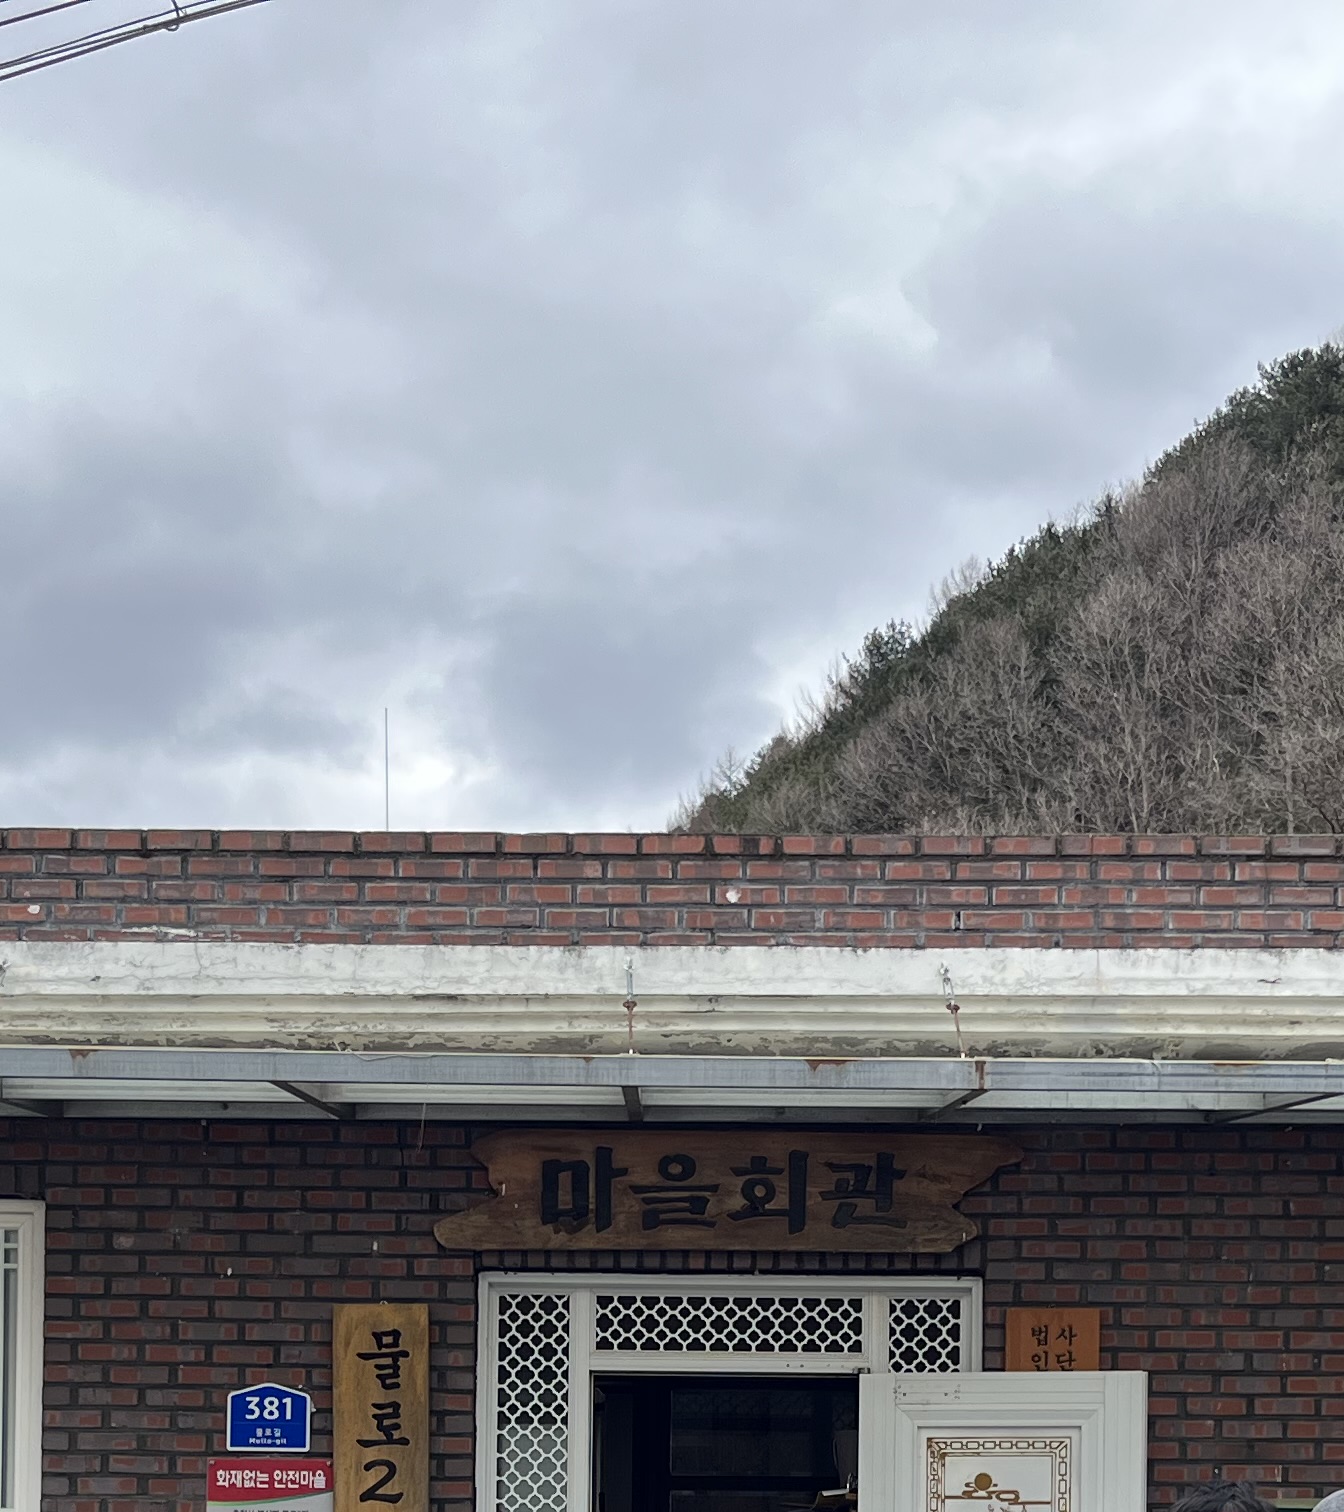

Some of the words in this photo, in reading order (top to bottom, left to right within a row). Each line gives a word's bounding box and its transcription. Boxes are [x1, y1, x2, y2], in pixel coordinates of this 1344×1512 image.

[540, 1146, 907, 1234] 마을회관
[245, 1396, 292, 1420] 381
[216, 1469, 269, 1489] 화재없는
[273, 1469, 327, 1489] 안전마을
